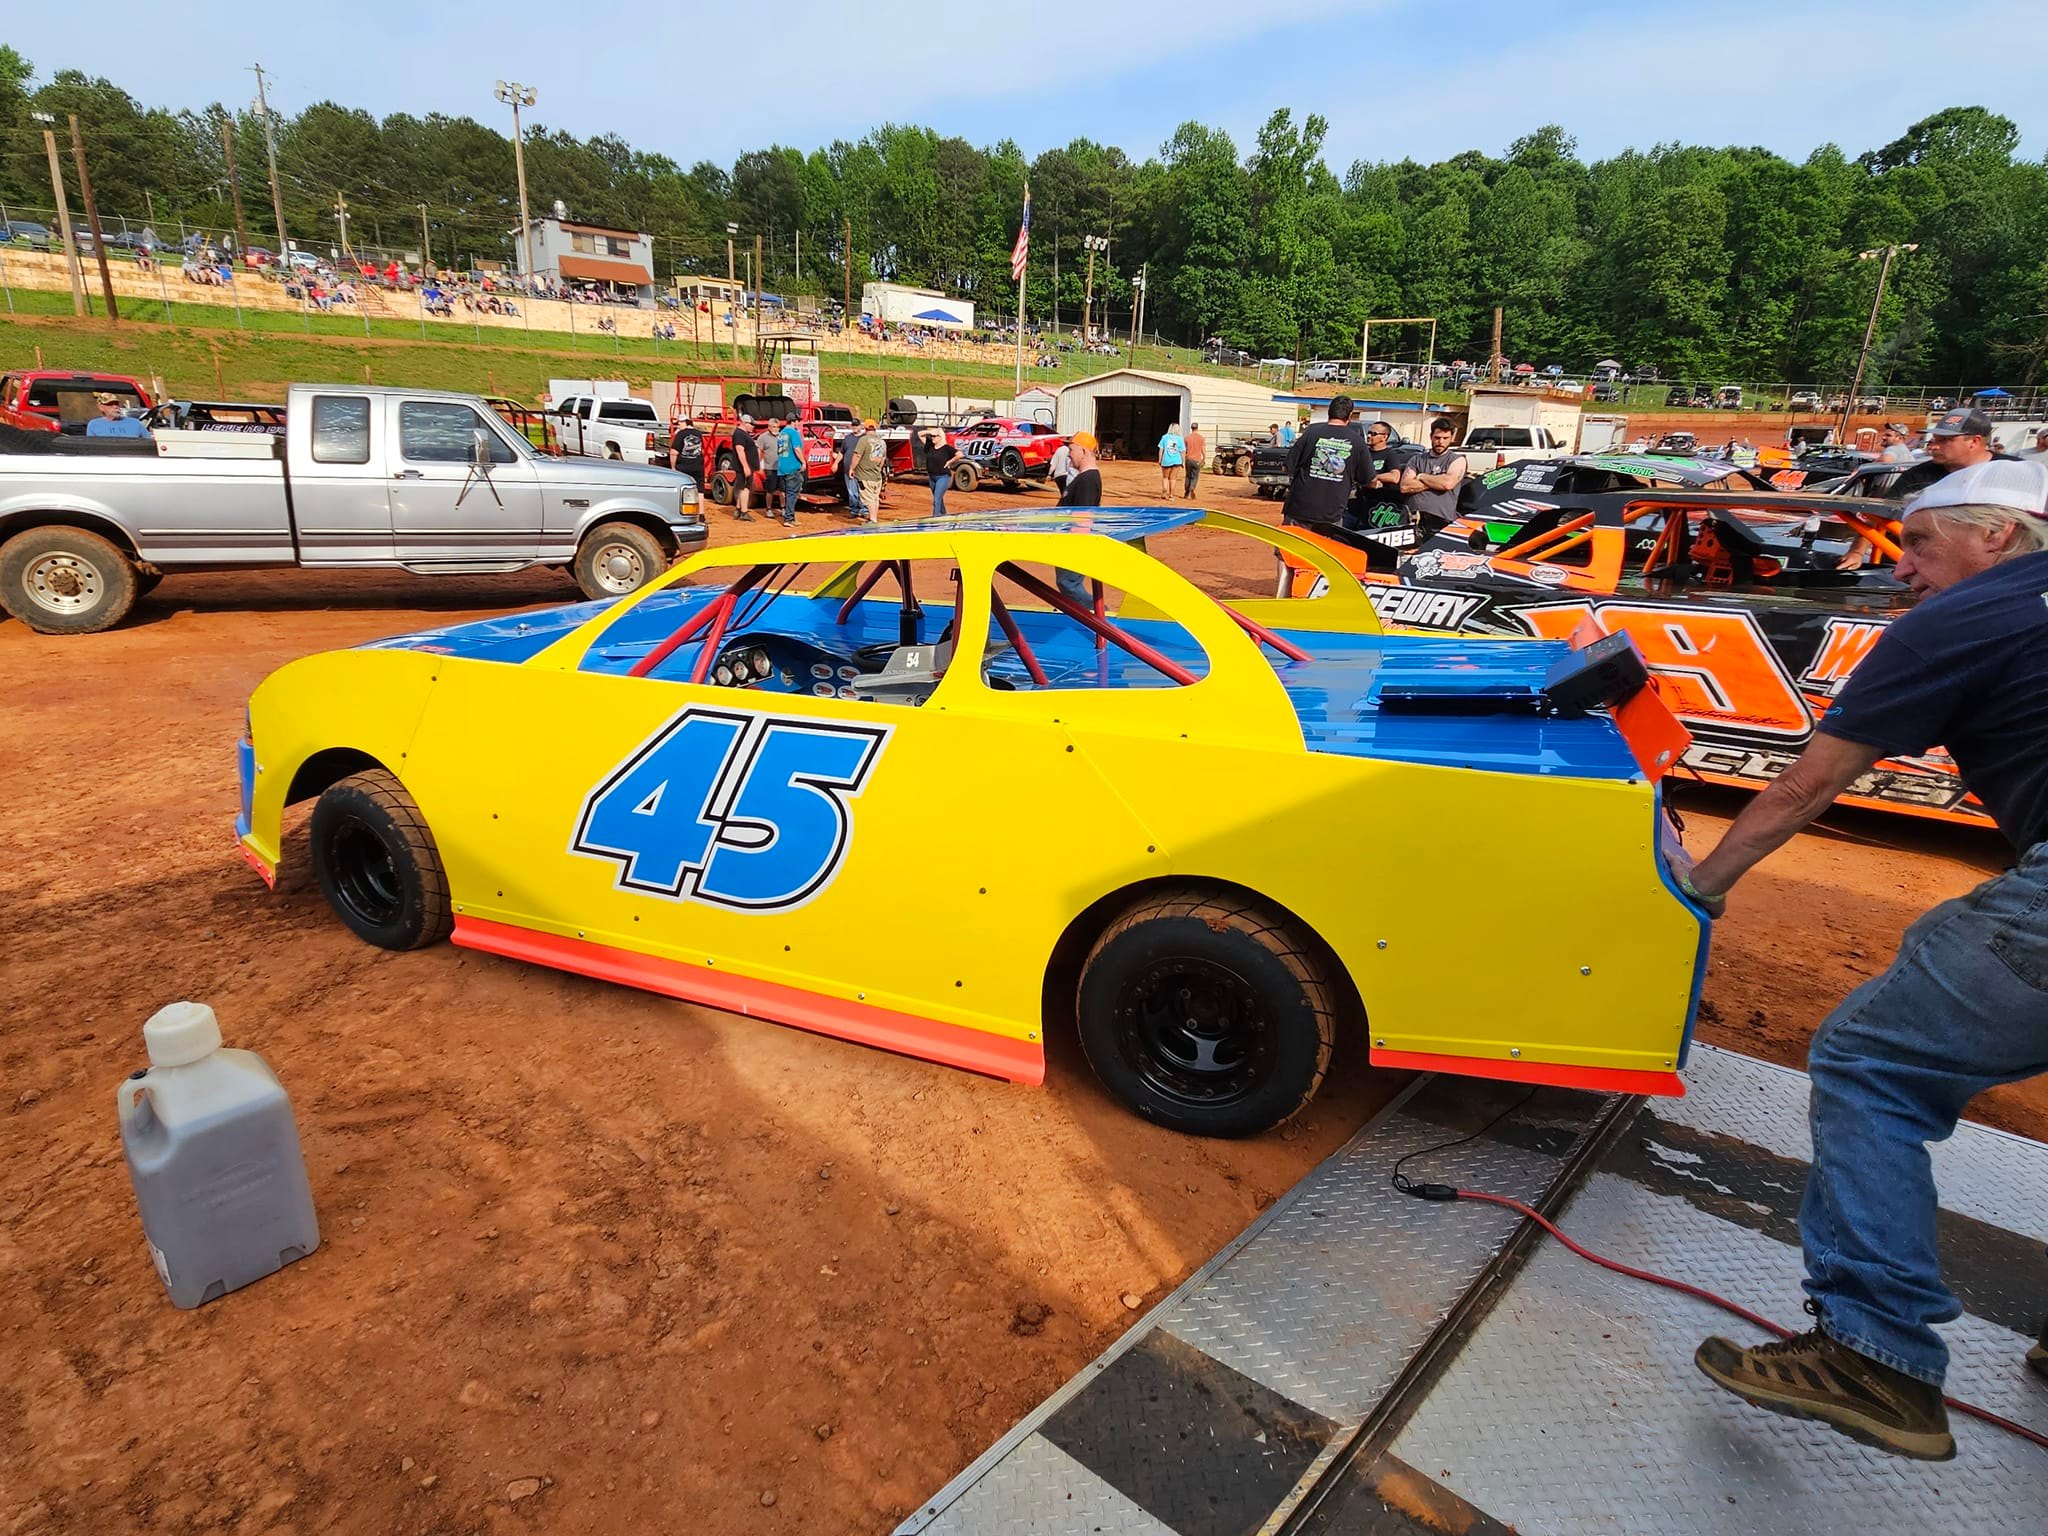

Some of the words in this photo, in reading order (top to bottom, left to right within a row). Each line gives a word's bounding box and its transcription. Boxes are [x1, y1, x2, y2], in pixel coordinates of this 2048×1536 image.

[968, 440, 995, 456] 09
[1619, 465, 1656, 477] CRONIC
[1366, 529, 1416, 548] OBS
[906, 651, 920, 668] 54
[568, 703, 894, 914] 45
